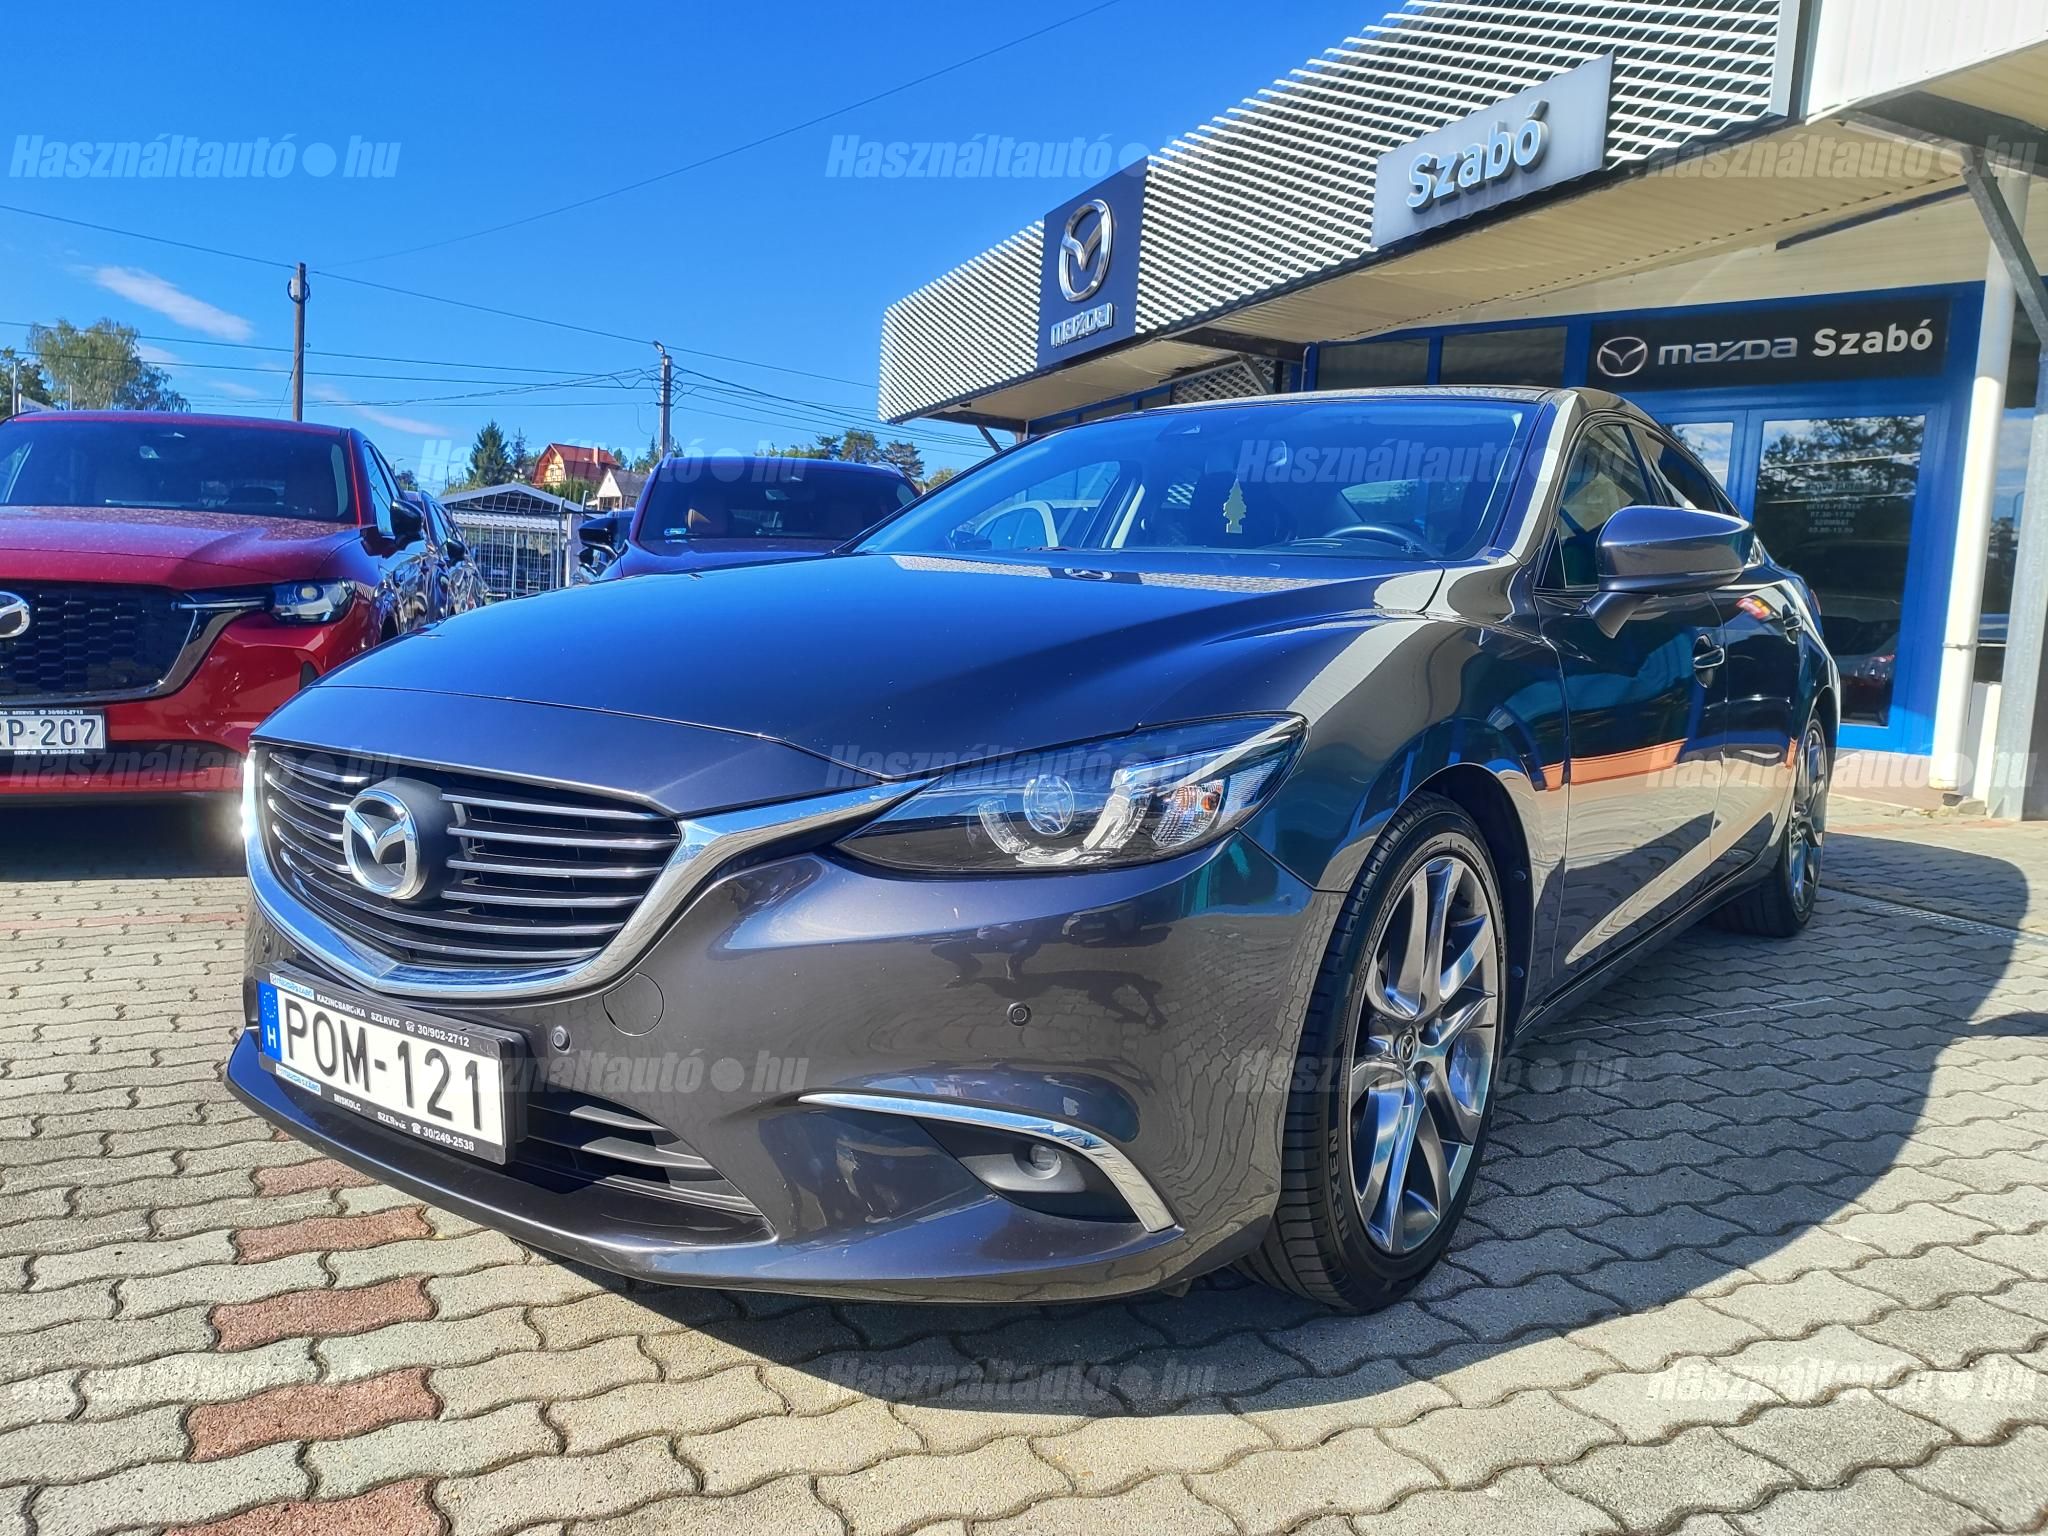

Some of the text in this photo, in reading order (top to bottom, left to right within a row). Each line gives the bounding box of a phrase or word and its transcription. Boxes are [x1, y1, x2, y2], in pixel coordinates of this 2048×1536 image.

[1406, 101, 1548, 209] Szabó
[1050, 303, 1113, 348] mazda
[1657, 319, 1934, 366] mazda Szabó
[0, 719, 96, 746] P-207
[266, 1024, 278, 1050] H
[370, 1012, 400, 1029] SZERVIZ
[417, 1024, 470, 1048] 30/902-2712
[284, 997, 482, 1132] POM-121
[333, 1093, 362, 1111] MISKOLC
[422, 1126, 475, 1152] 30/249-2538
[1328, 1127, 1351, 1241] NEXEN
